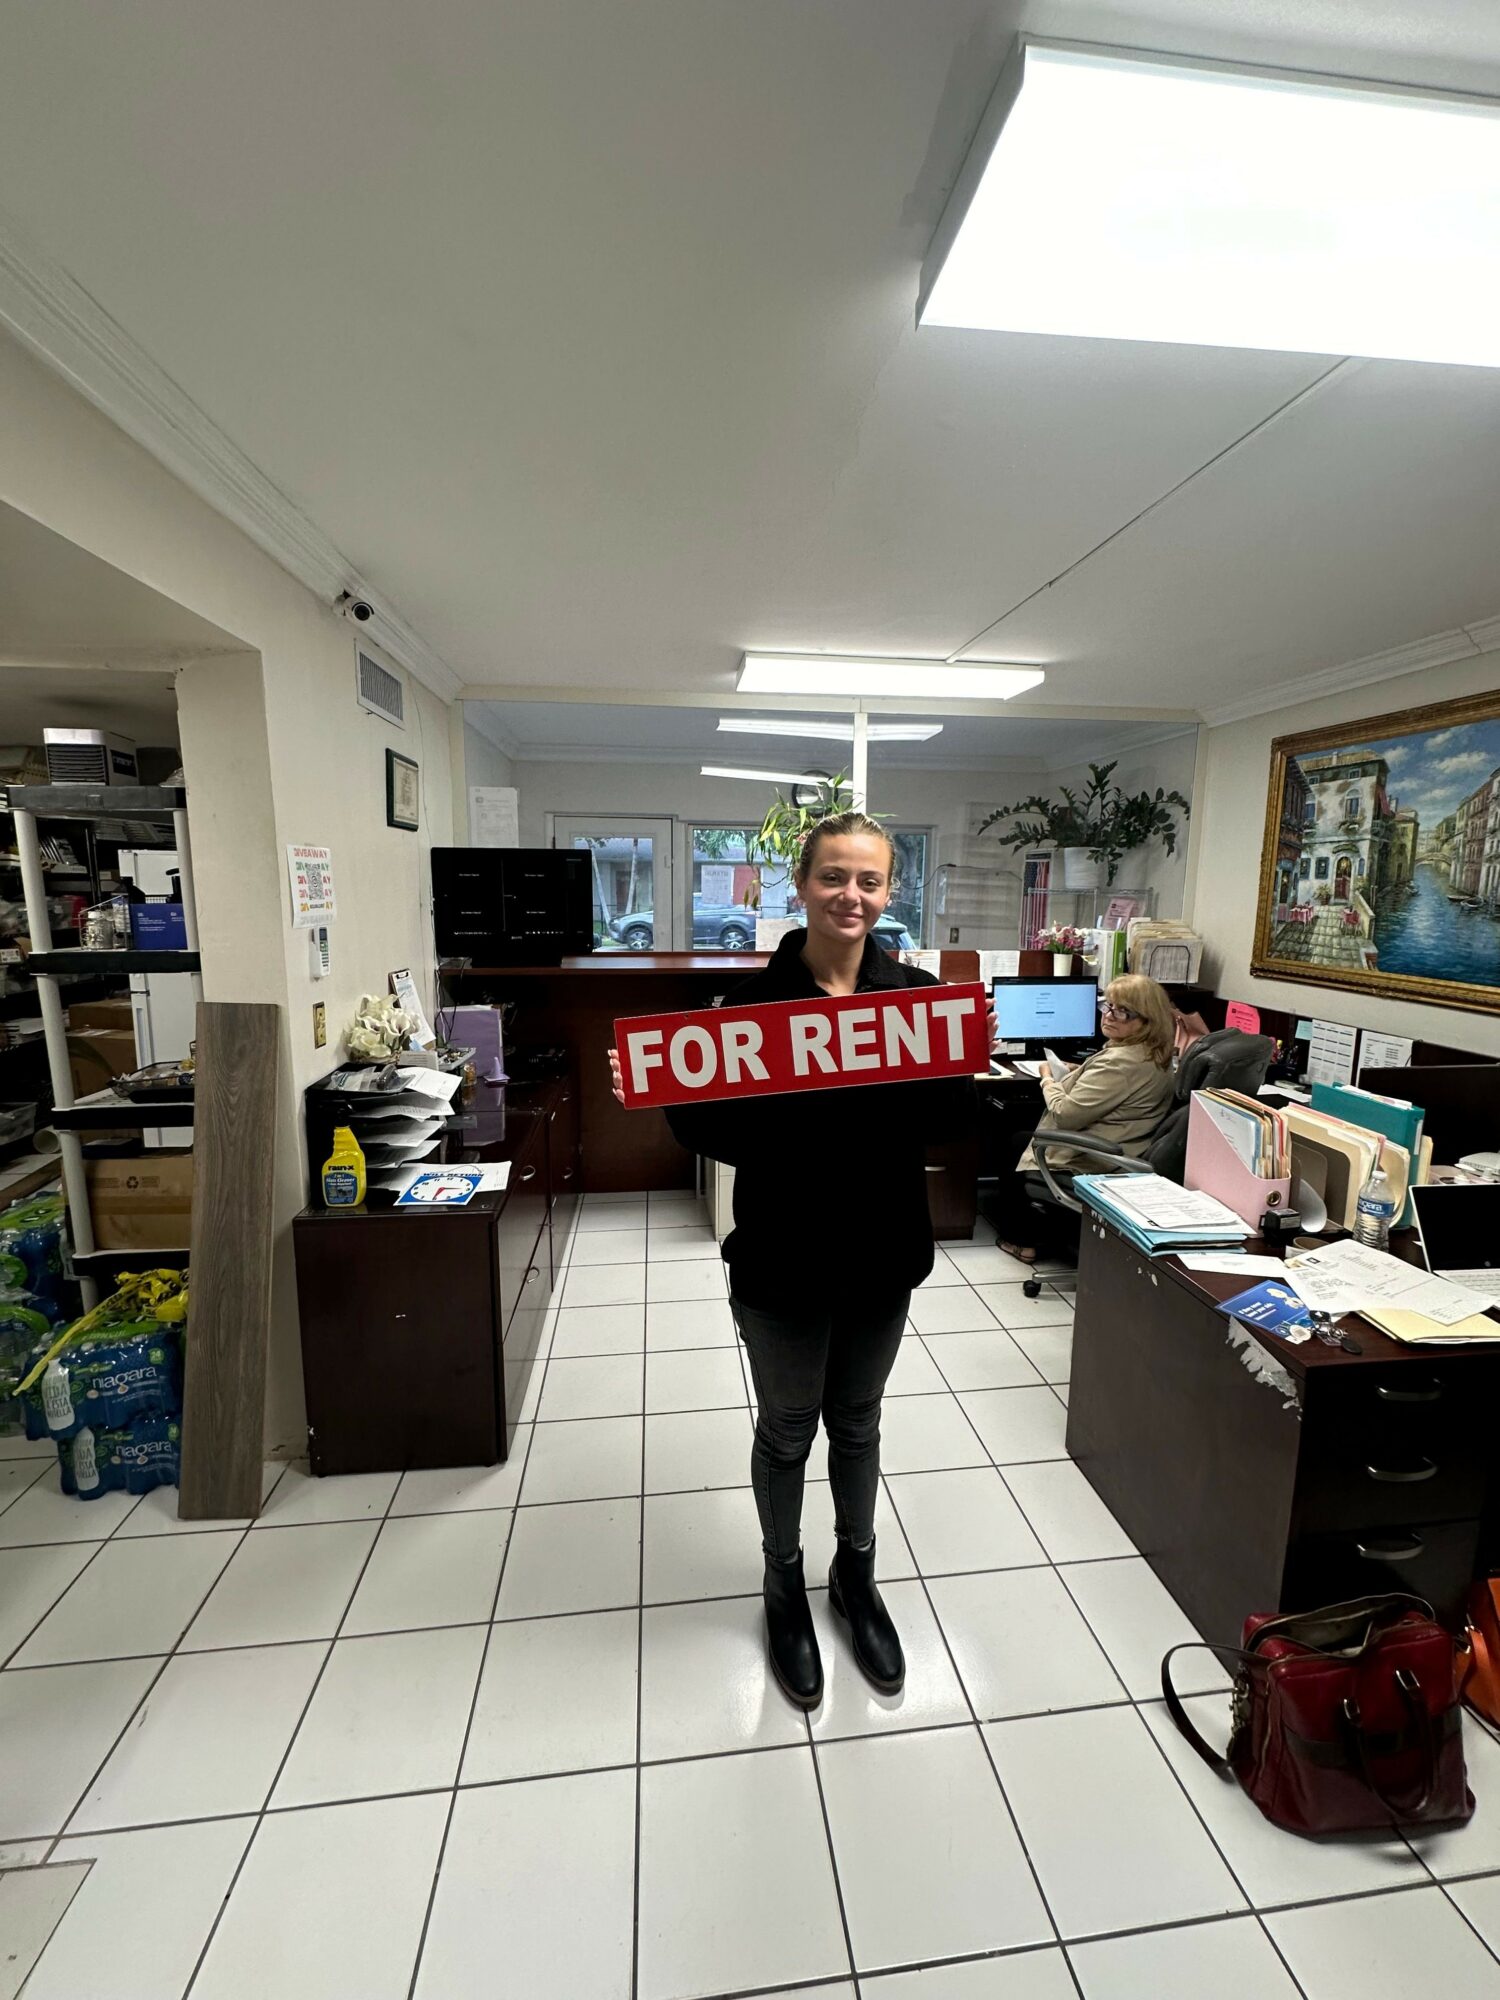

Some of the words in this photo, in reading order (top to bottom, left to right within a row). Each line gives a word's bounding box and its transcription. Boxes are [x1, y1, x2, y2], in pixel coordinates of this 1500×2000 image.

[293, 847, 328, 859] GIVEAWAY
[627, 1020, 770, 1094] FOR
[789, 998, 975, 1077] RENT
[92, 1366, 158, 1391] niagara
